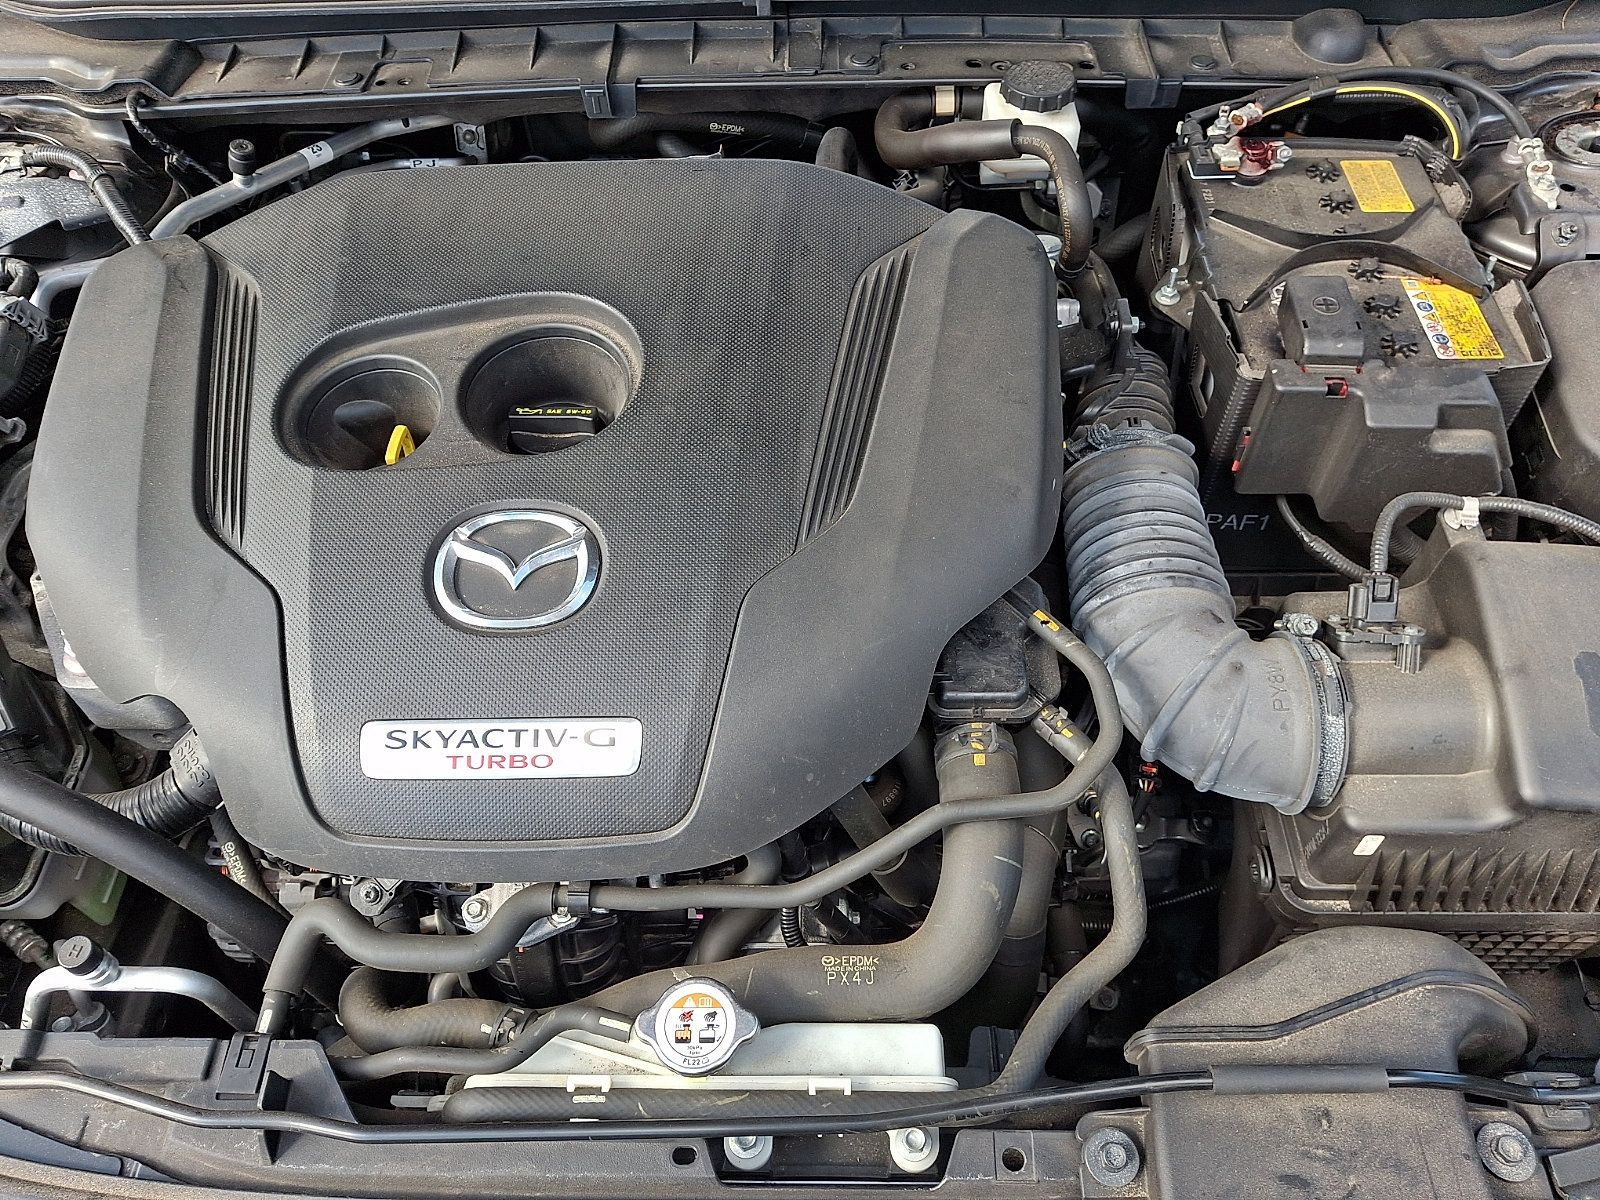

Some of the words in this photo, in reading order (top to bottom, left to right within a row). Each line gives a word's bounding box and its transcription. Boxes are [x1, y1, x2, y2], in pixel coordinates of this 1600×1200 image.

[1206, 513, 1270, 531] PAF1
[384, 727, 616, 750] SKYACTIV-G
[445, 753, 554, 770] TURBO
[68, 944, 84, 959] H
